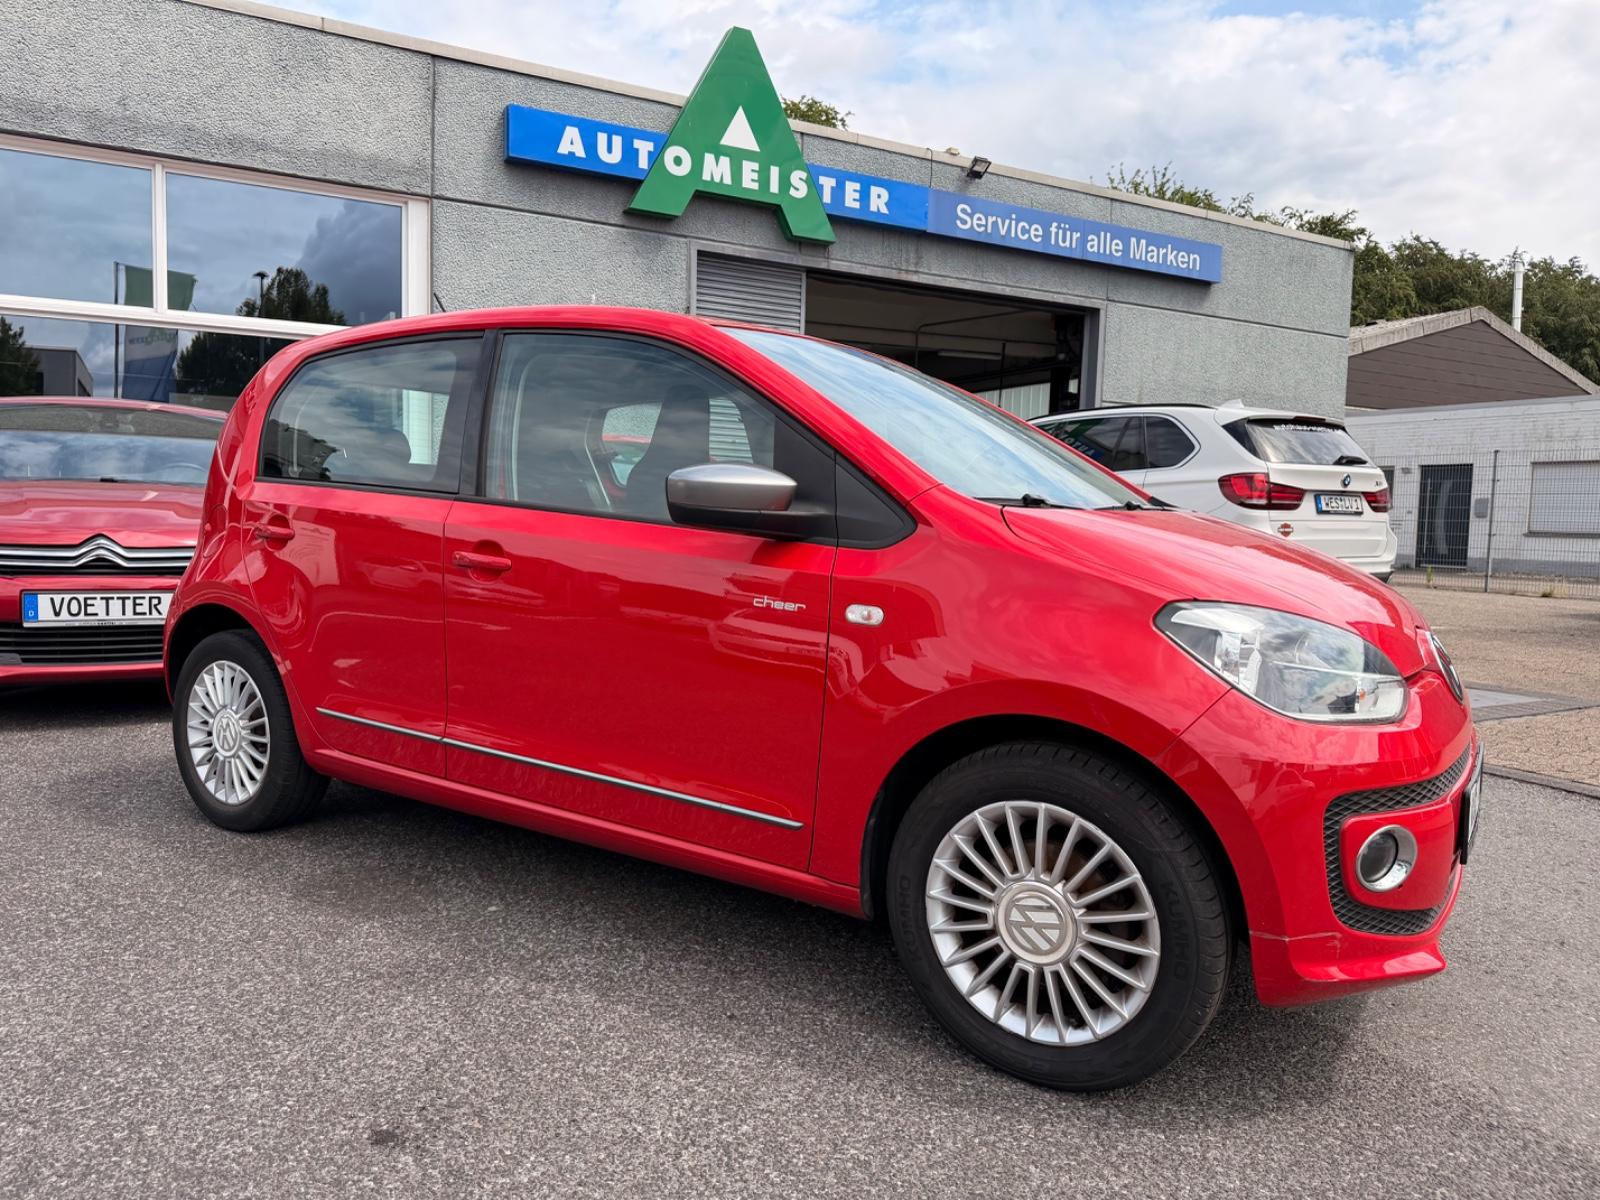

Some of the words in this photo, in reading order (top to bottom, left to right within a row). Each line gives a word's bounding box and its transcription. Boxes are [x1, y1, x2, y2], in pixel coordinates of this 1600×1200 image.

[557, 125, 889, 214] AUTOMEISTER
[955, 203, 1043, 243] Service
[1049, 221, 1081, 249] für
[1087, 231, 1123, 257] alle
[1130, 236, 1200, 271] Marken
[50, 596, 163, 617] VOETTER
[753, 595, 806, 612] cheer
[1160, 880, 1190, 981] KUMHO
